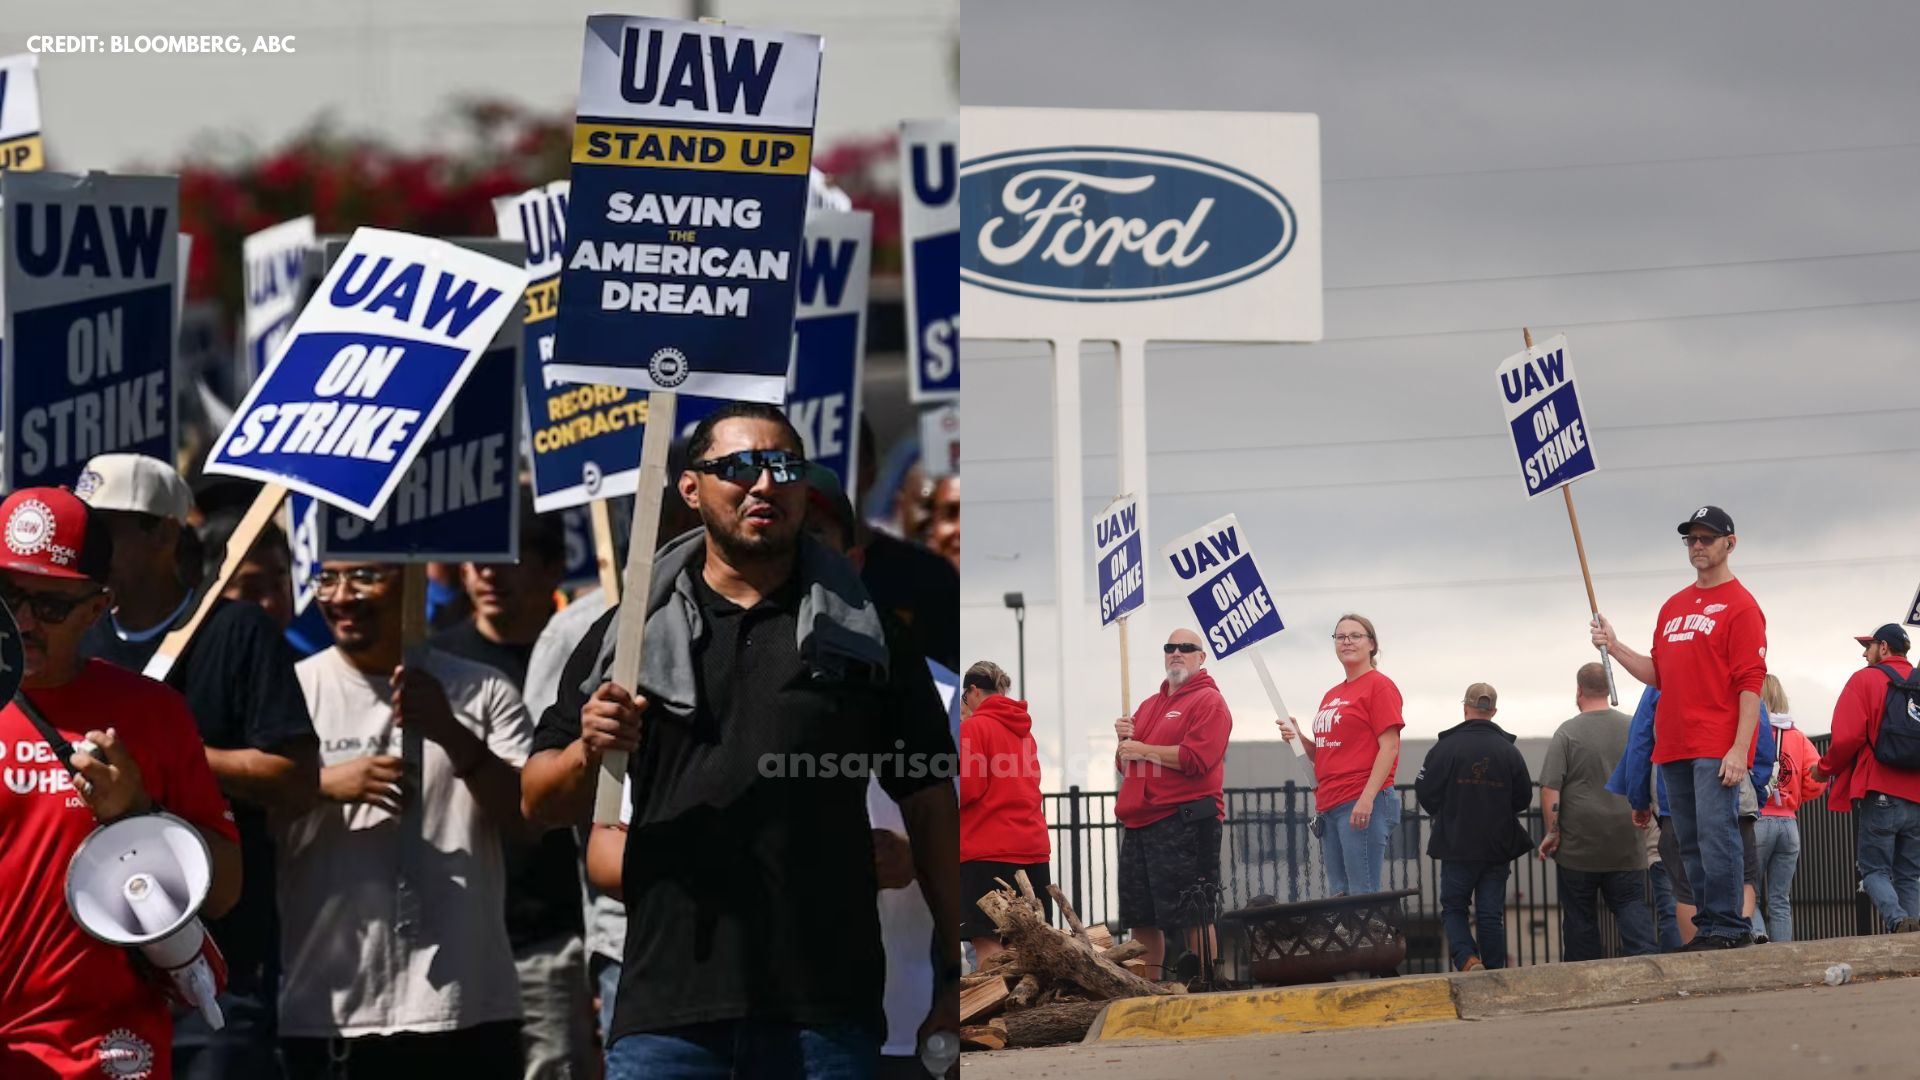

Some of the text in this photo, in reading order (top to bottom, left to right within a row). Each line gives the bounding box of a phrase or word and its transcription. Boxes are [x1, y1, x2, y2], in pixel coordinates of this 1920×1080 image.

[620, 26, 784, 117] UAW
[587, 131, 796, 168] STAND UP
[519, 194, 569, 266] UA
[606, 192, 762, 229] SAVING
[668, 230, 696, 243] THE
[978, 168, 1216, 268] Ford
[15, 202, 168, 279] UAW
[568, 240, 791, 281] AMERICAN
[329, 252, 504, 340] UAW
[601, 280, 750, 317] DREAM
[66, 305, 124, 387] ON
[313, 343, 406, 399] ON
[1501, 348, 1565, 404] UAW
[20, 368, 165, 477] STRIKE
[226, 401, 421, 464] STRIKE
[1532, 399, 1560, 443] ON
[1525, 417, 1586, 490] STRIKE
[337, 432, 504, 541] RIKE
[1096, 502, 1137, 549] UAW
[1169, 525, 1241, 580] UAW
[1101, 560, 1142, 621] STRIKE
[1110, 545, 1128, 581] ON
[1211, 572, 1242, 612] ON
[1208, 585, 1272, 654] STRIKE
